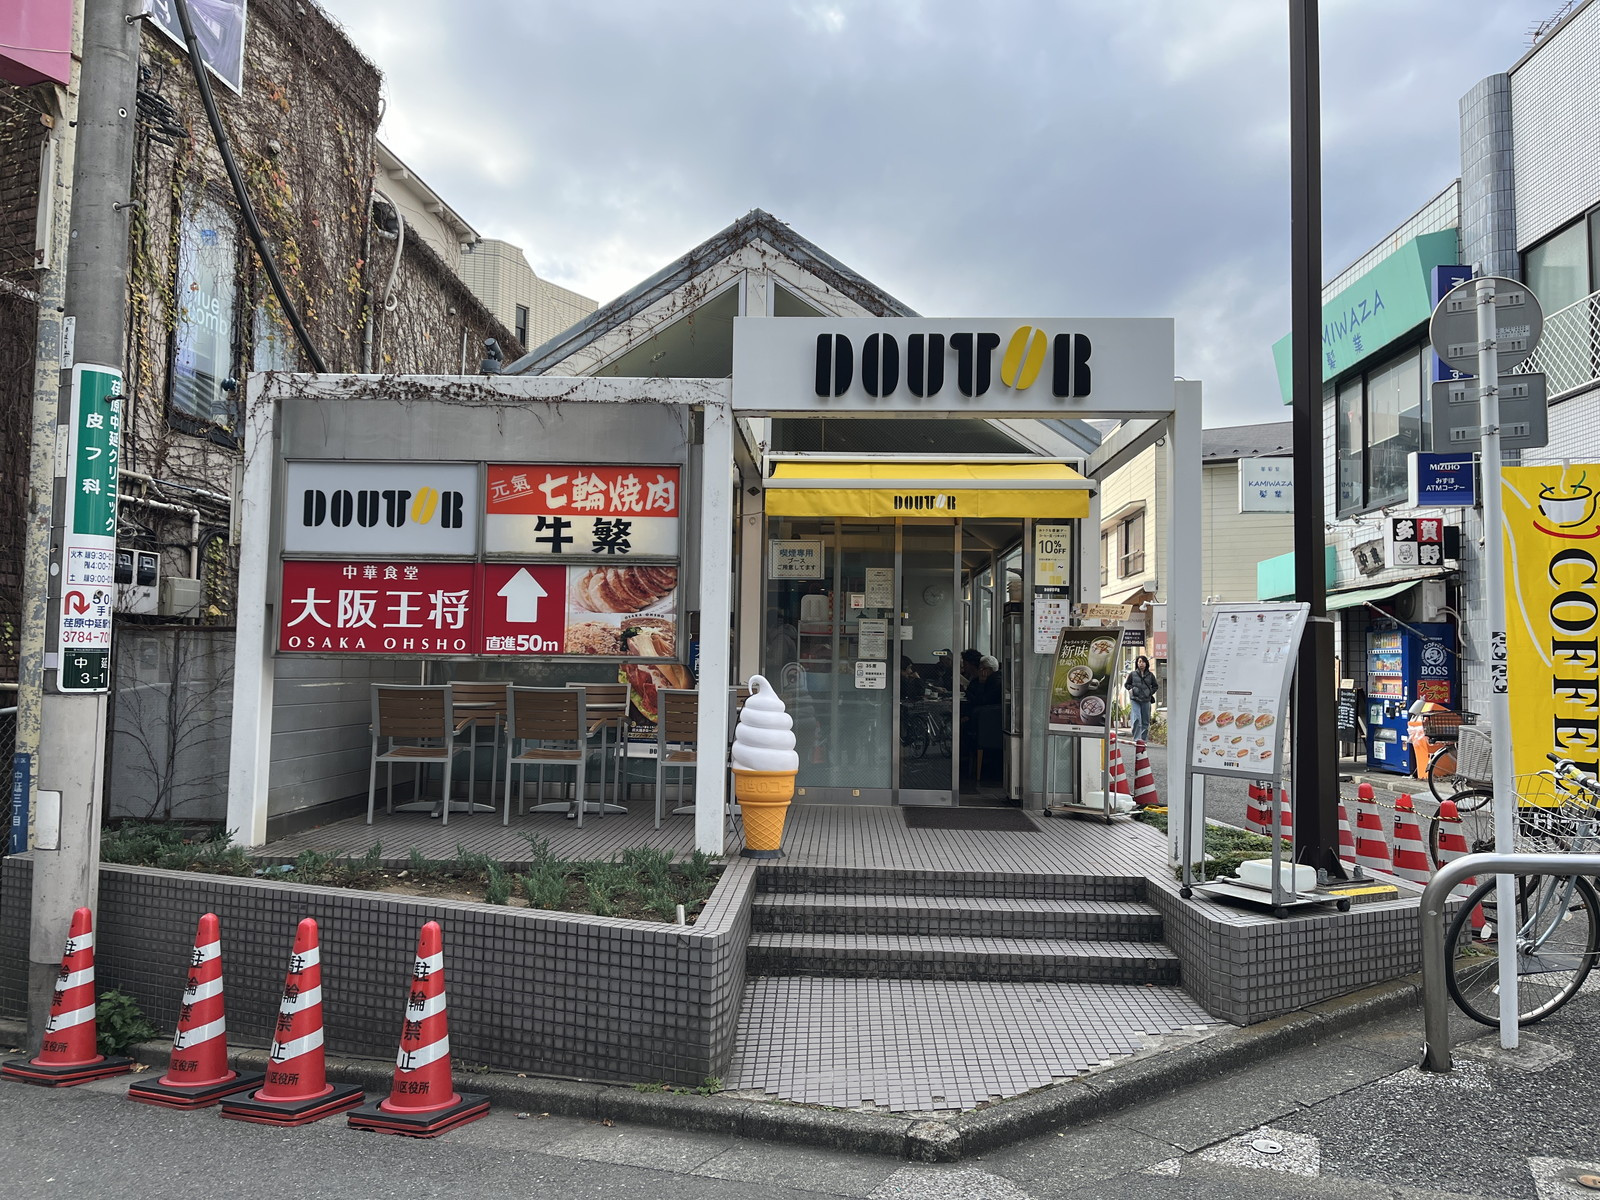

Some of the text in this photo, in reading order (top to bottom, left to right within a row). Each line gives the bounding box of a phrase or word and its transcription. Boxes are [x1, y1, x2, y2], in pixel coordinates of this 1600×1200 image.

[1322, 289, 1384, 347] MIWAZA
[815, 326, 1092, 398] DOUTOR
[82, 412, 104, 496] 皮フ科
[303, 486, 464, 529] DOUTOR
[489, 473, 676, 513] 元氣 七輪焼肉
[894, 493, 956, 510] DOUTOR
[534, 515, 633, 554] 牛繁
[342, 564, 419, 581] 中華食堂
[287, 587, 470, 630] 大阪王将
[62, 631, 110, 643] 3784-70
[288, 635, 467, 651] OSAKA OHSHO
[485, 634, 559, 652] 直進50m
[74, 657, 108, 669] 中延
[80, 672, 104, 684] 3-1
[1421, 665, 1448, 676] BOSS
[271, 955, 306, 1061] 駐輪禁止
[399, 961, 431, 1070] 駐輪禁止
